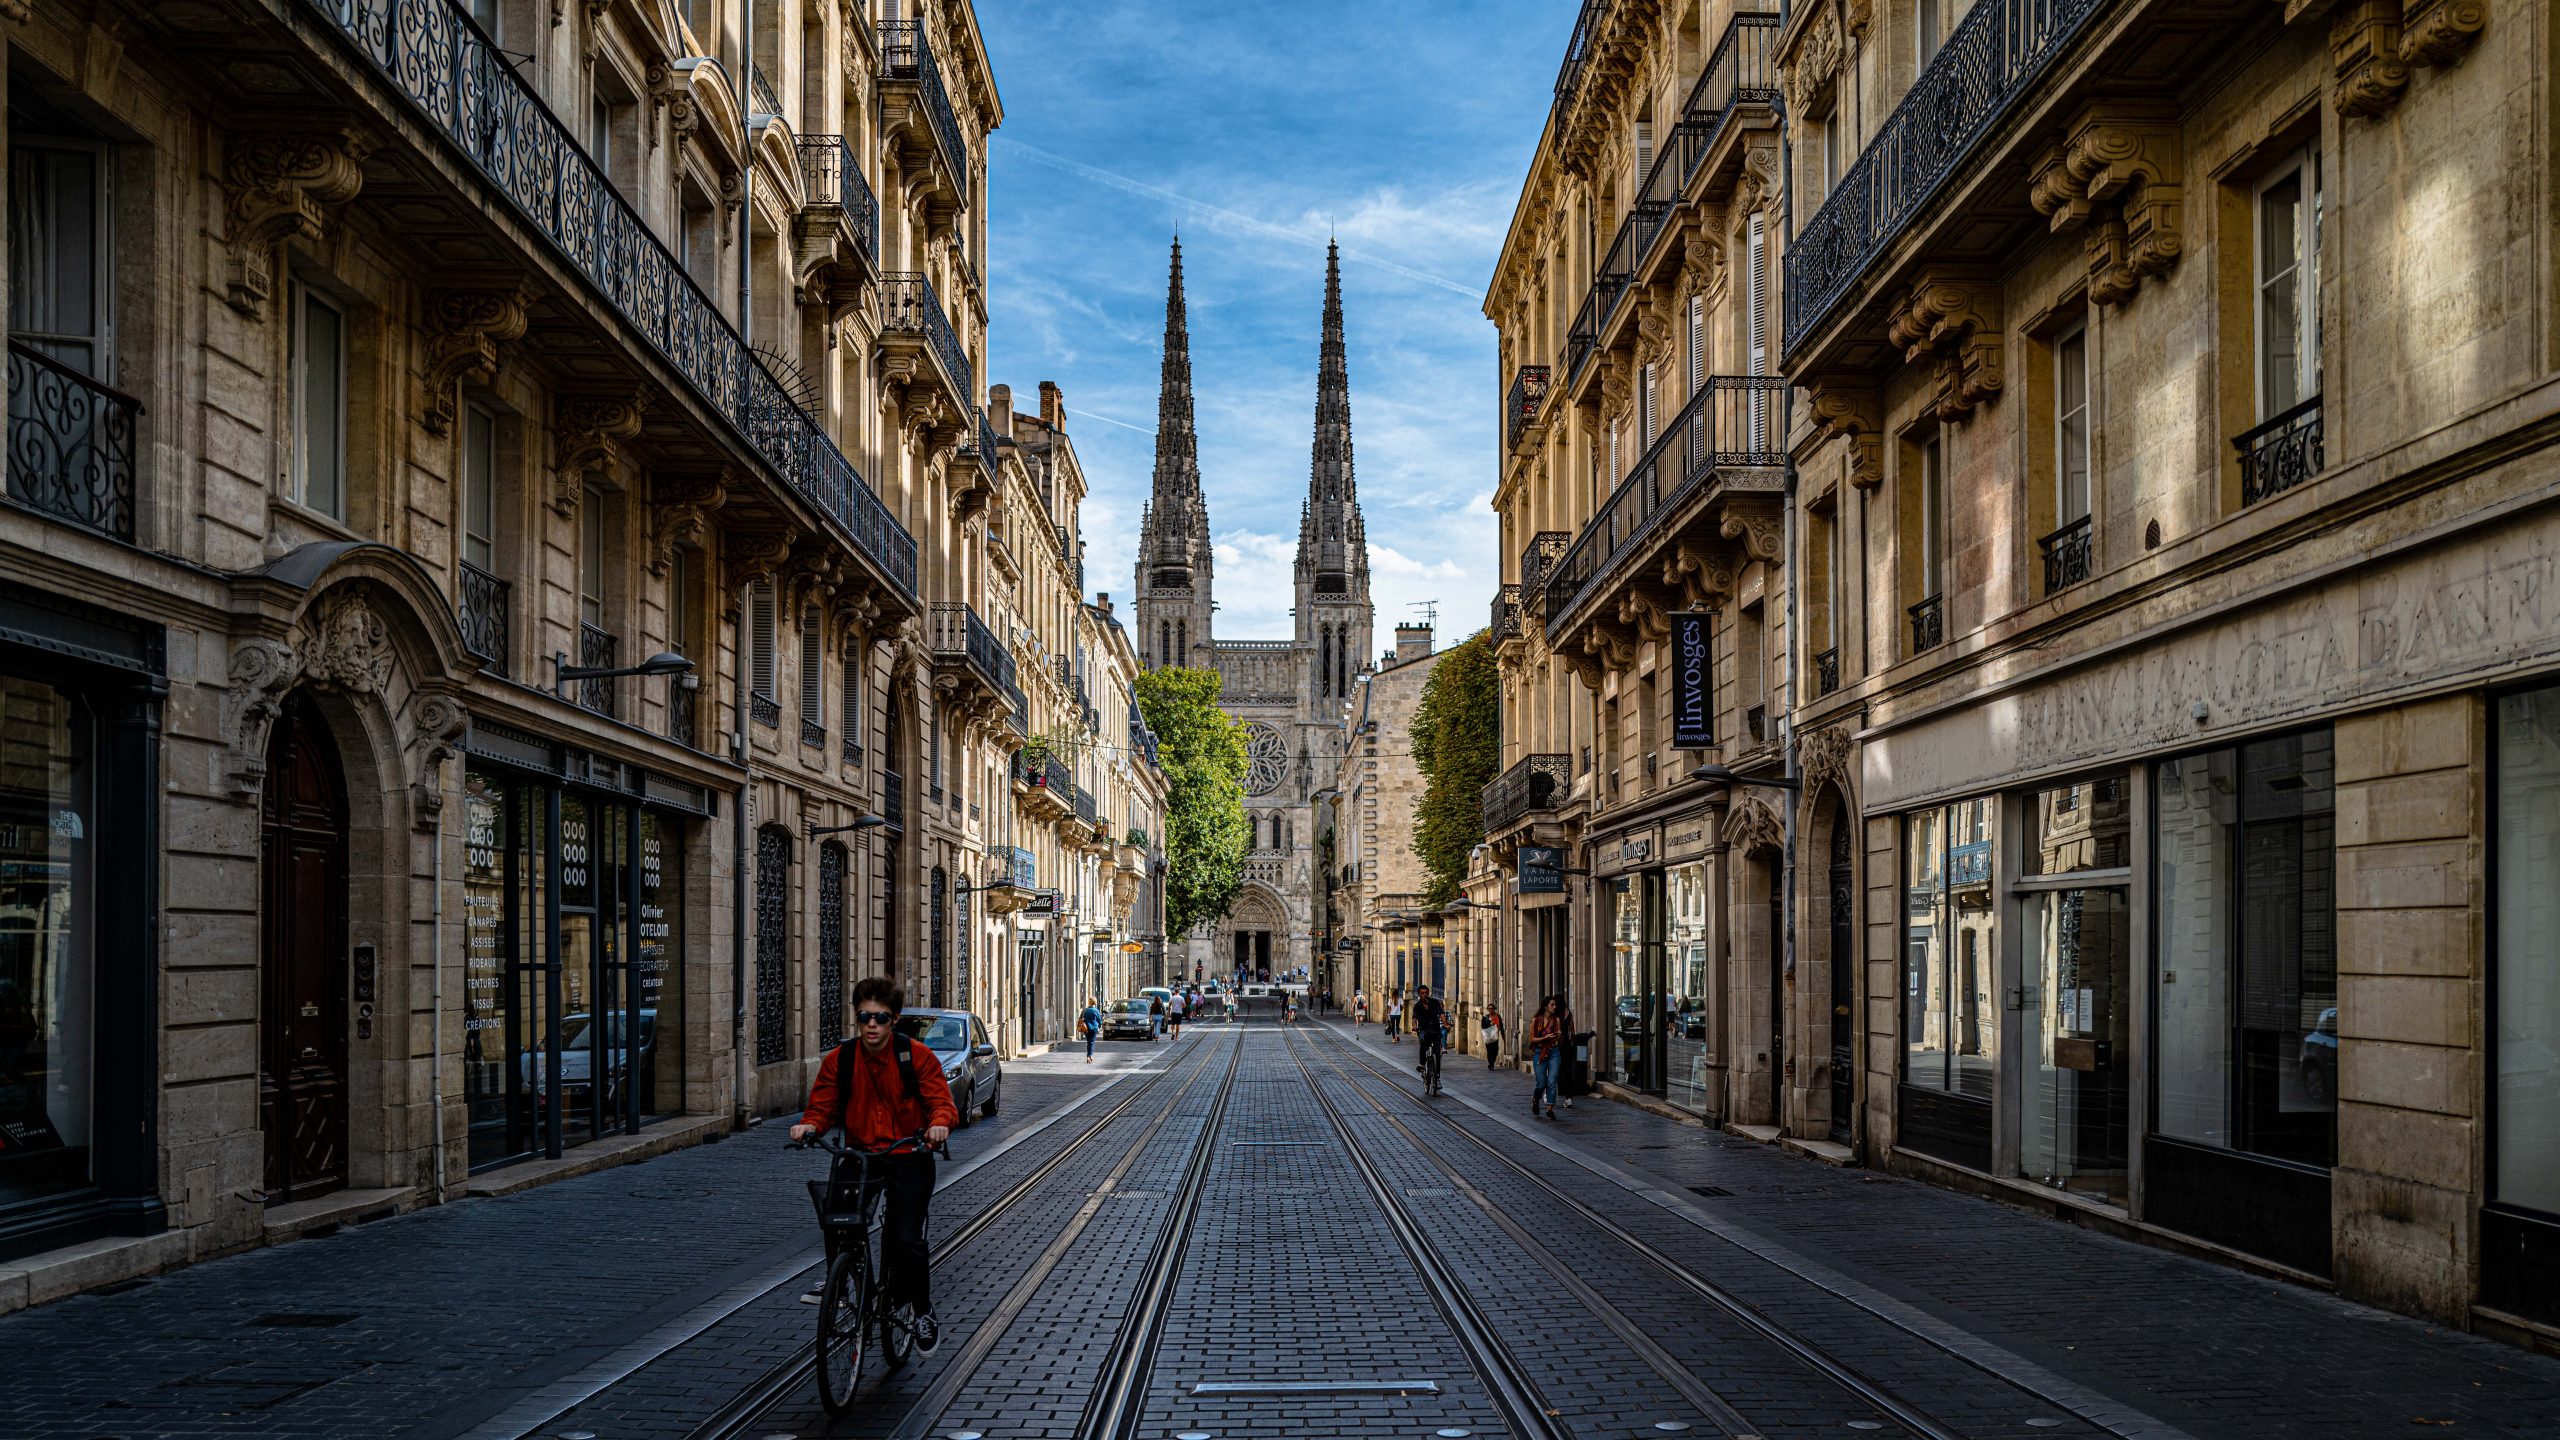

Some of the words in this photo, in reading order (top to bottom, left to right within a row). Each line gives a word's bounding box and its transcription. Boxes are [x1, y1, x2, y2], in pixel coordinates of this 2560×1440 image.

[1678, 619, 1706, 731] linvosges
[60, 810, 73, 820] THE
[49, 818, 73, 829] NORTH
[56, 828, 73, 838] FACE
[1523, 876, 1559, 885] LAPORTE
[465, 895, 499, 907] FAUTEUILS
[641, 903, 664, 918] Olivier
[468, 914, 498, 928] CANAPÉS
[470, 937, 496, 948] ASSISES
[469, 957, 497, 969] RIDEAUX
[640, 957, 670, 972] ÉCORATEUR
[467, 977, 499, 989] TENTURES
[642, 976, 664, 988] CRÉATEUR
[473, 998, 494, 1010] TISSUS
[465, 1017, 501, 1031] CRÉATIONS
